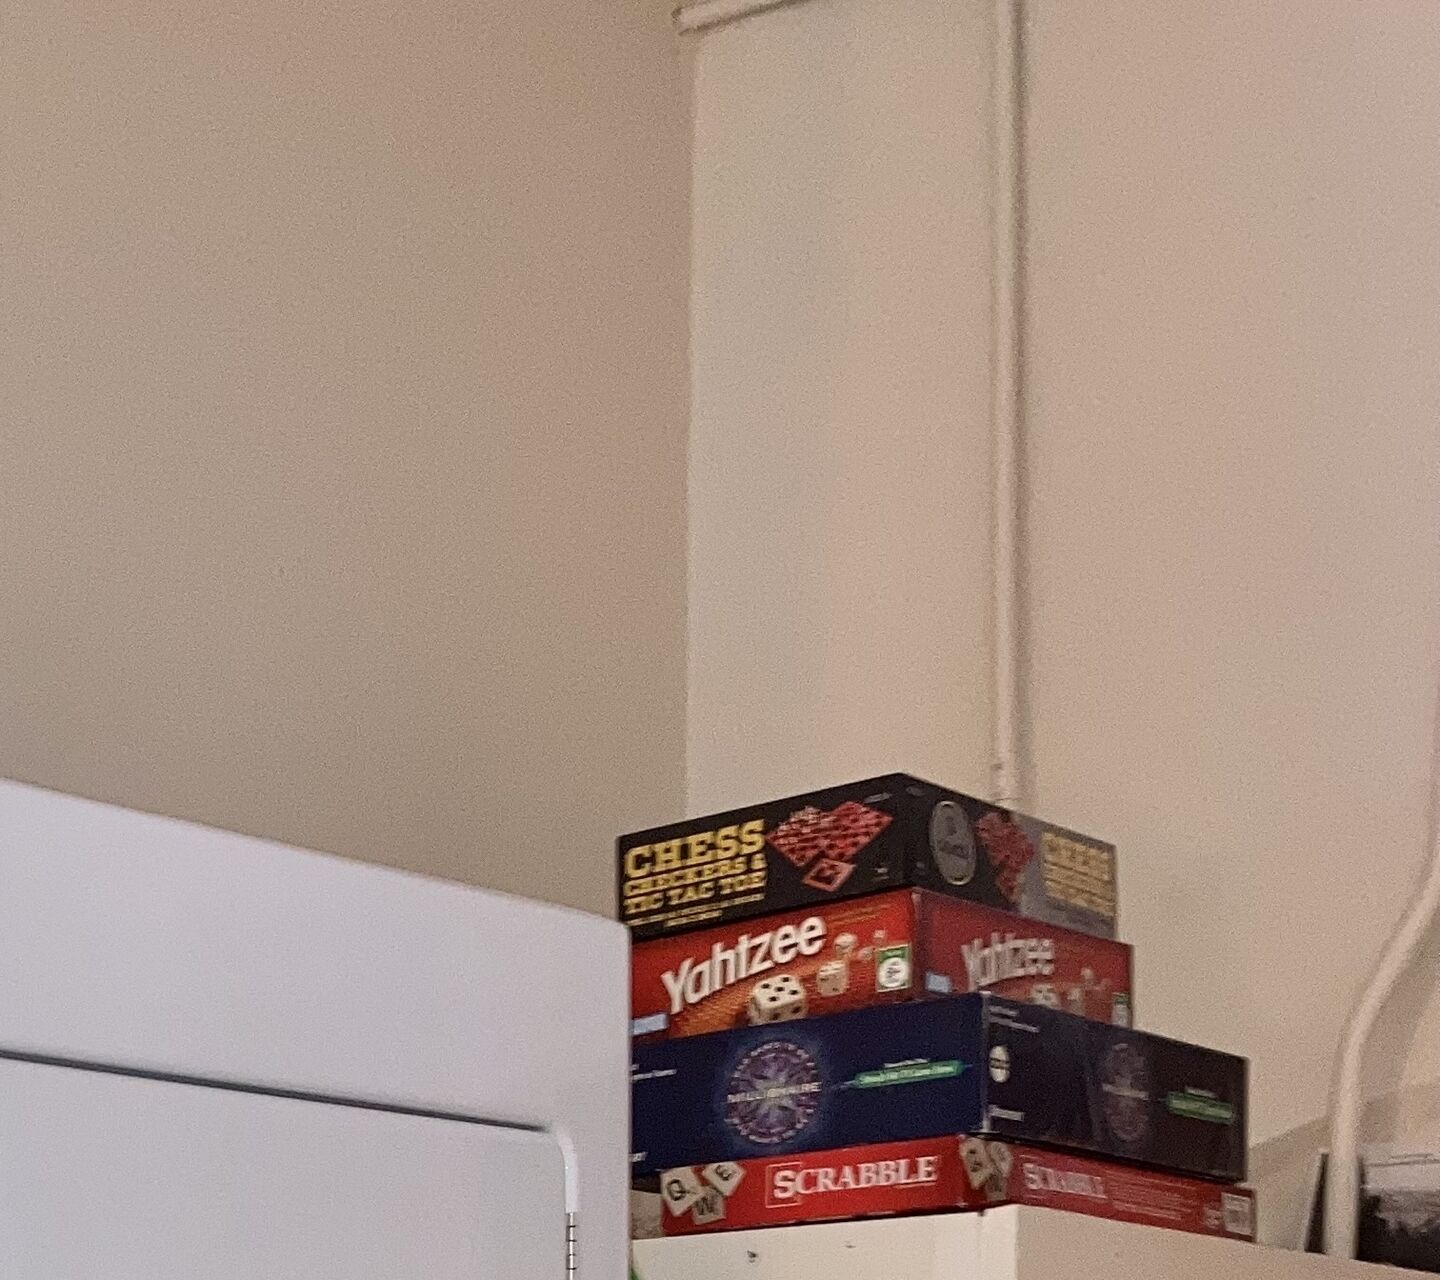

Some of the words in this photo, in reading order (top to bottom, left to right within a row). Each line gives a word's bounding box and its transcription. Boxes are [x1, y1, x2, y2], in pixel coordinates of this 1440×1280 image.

[625, 819, 766, 879] CHESS
[623, 856, 748, 897] CHECKERS
[623, 895, 665, 915] TIC
[665, 881, 715, 906] TAC
[661, 916, 827, 1015] Yahtzee
[961, 931, 1055, 992] Yahtzee
[773, 1155, 939, 1199] SCRABBLE
